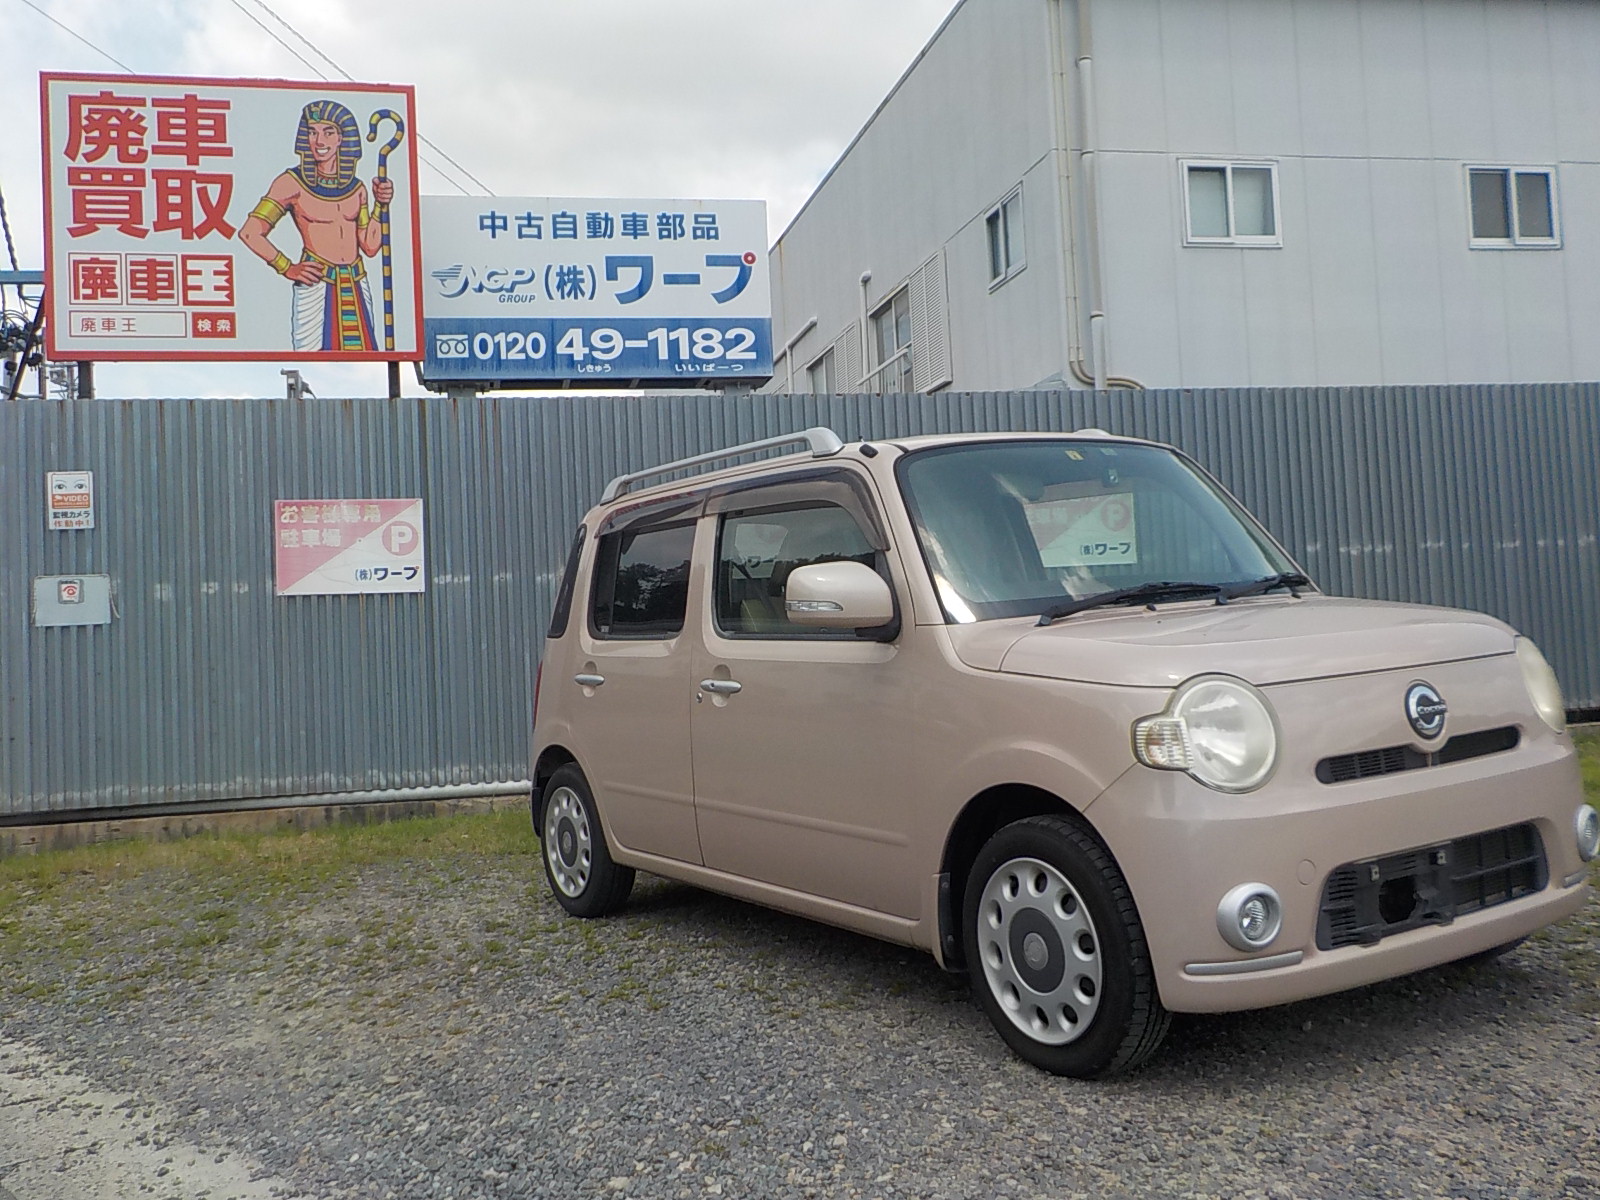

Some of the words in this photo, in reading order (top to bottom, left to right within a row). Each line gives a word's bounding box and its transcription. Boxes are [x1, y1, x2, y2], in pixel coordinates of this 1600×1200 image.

[64, 91, 233, 165] 廃車
[66, 167, 236, 240] 買取
[478, 210, 720, 241] 中古自動車部品
[498, 294, 536, 304] GROUP
[81, 317, 137, 333] 廃車王
[197, 319, 231, 333] 検索
[473, 332, 547, 361] 0120
[556, 327, 757, 361] 49-1182
[577, 363, 612, 373] しきゅう
[63, 494, 89, 502] VIDEO
[391, 525, 413, 552] P
